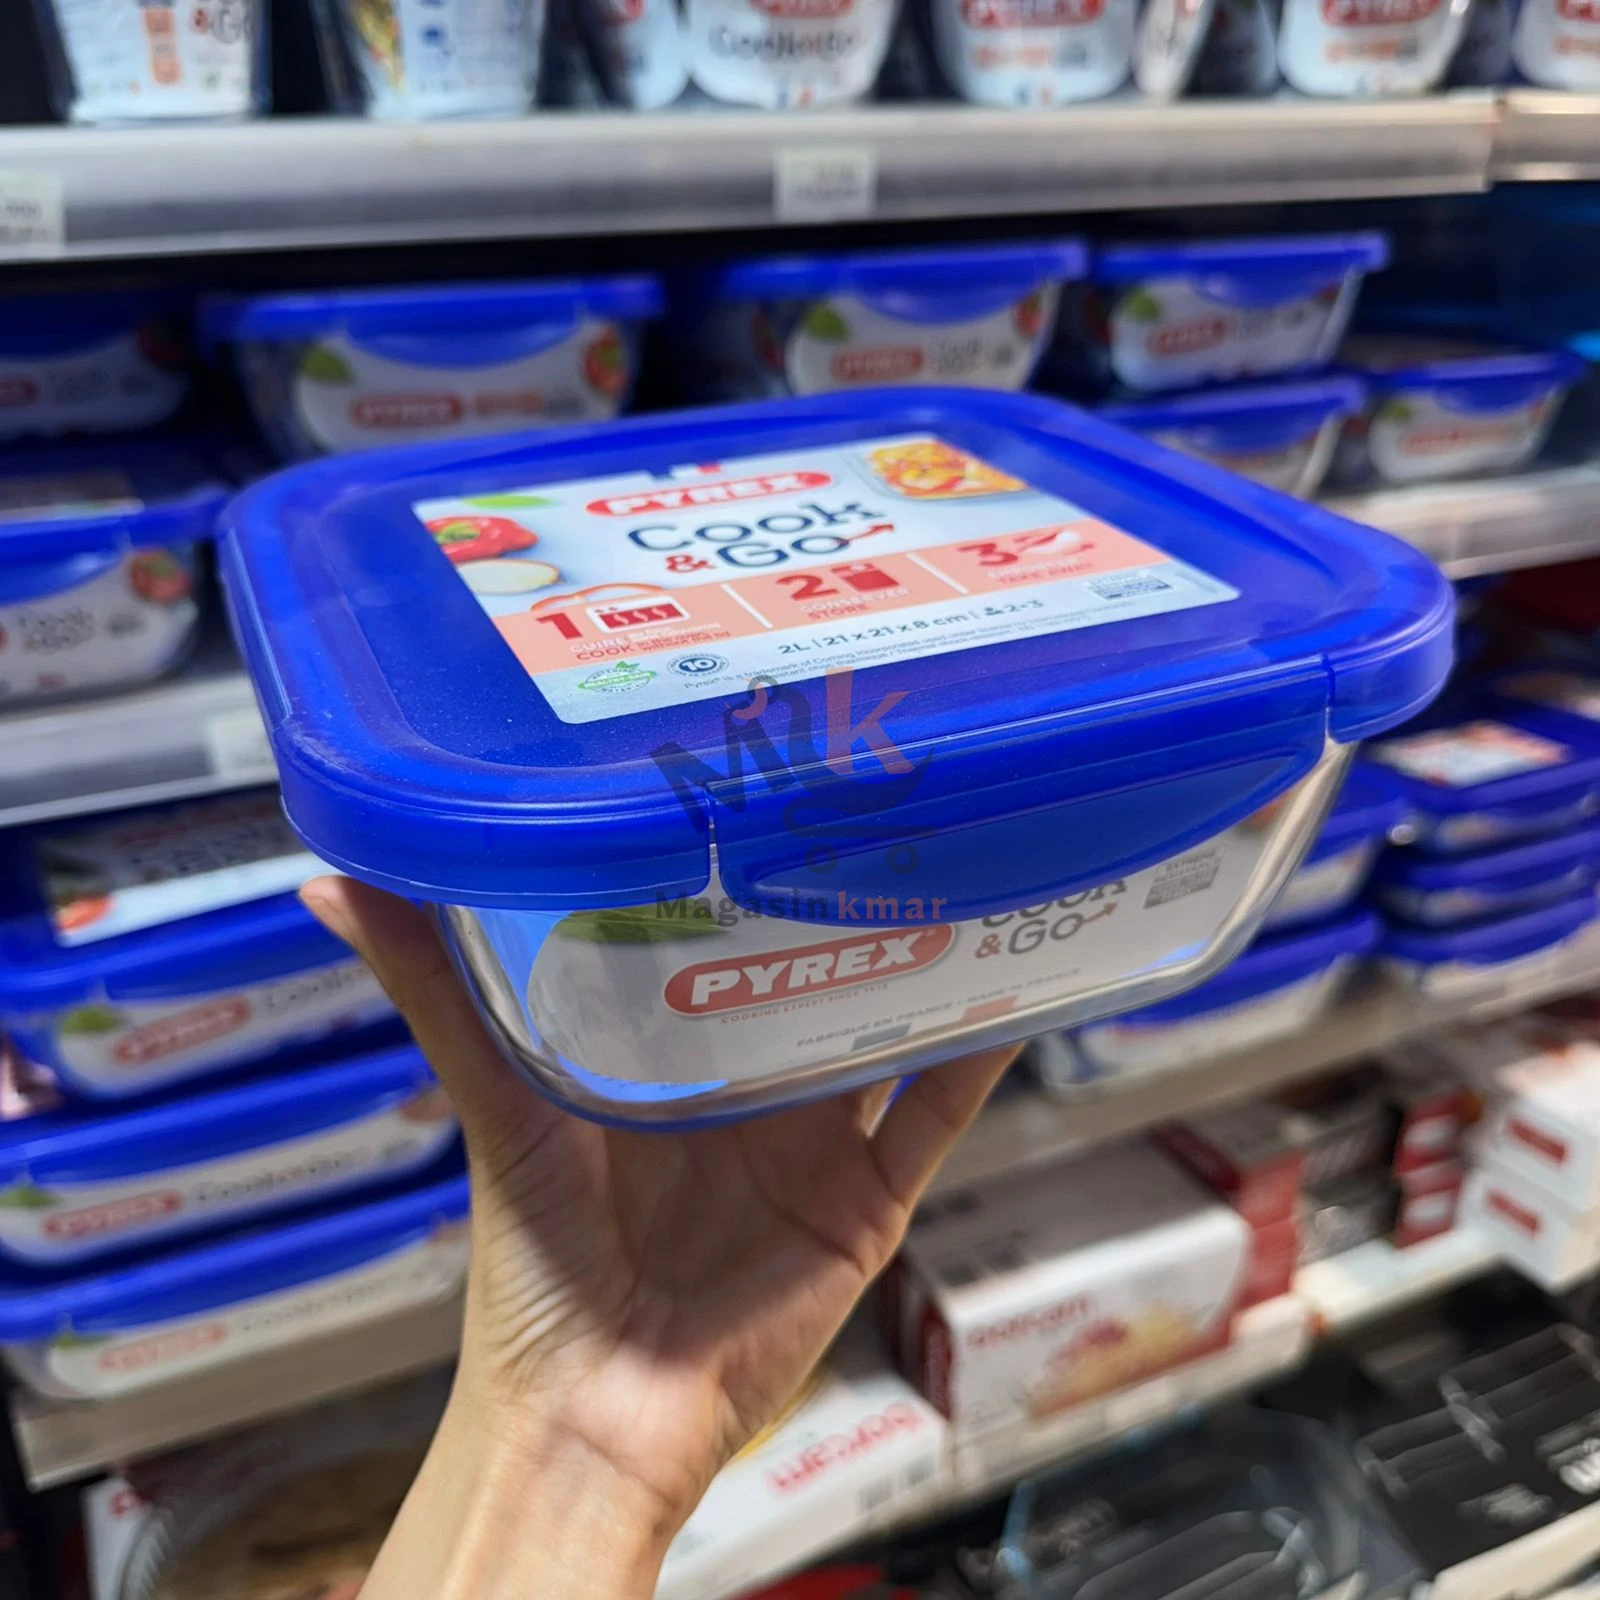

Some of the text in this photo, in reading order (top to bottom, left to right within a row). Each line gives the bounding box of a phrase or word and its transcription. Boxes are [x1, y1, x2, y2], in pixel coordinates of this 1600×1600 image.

[627, 501, 886, 551] Cook
[664, 554, 717, 573] &
[957, 541, 1018, 567] 3
[774, 573, 840, 602] 2
[537, 611, 583, 641] 1
[778, 643, 812, 655] 2L
[822, 634, 849, 646] 21
[868, 626, 894, 638] 21
[912, 620, 929, 629] 8
[932, 614, 969, 625] cm
[576, 645, 636, 660] COOK
[690, 931, 922, 1006] PYREX
[720, 1008, 780, 1024] COOKING
